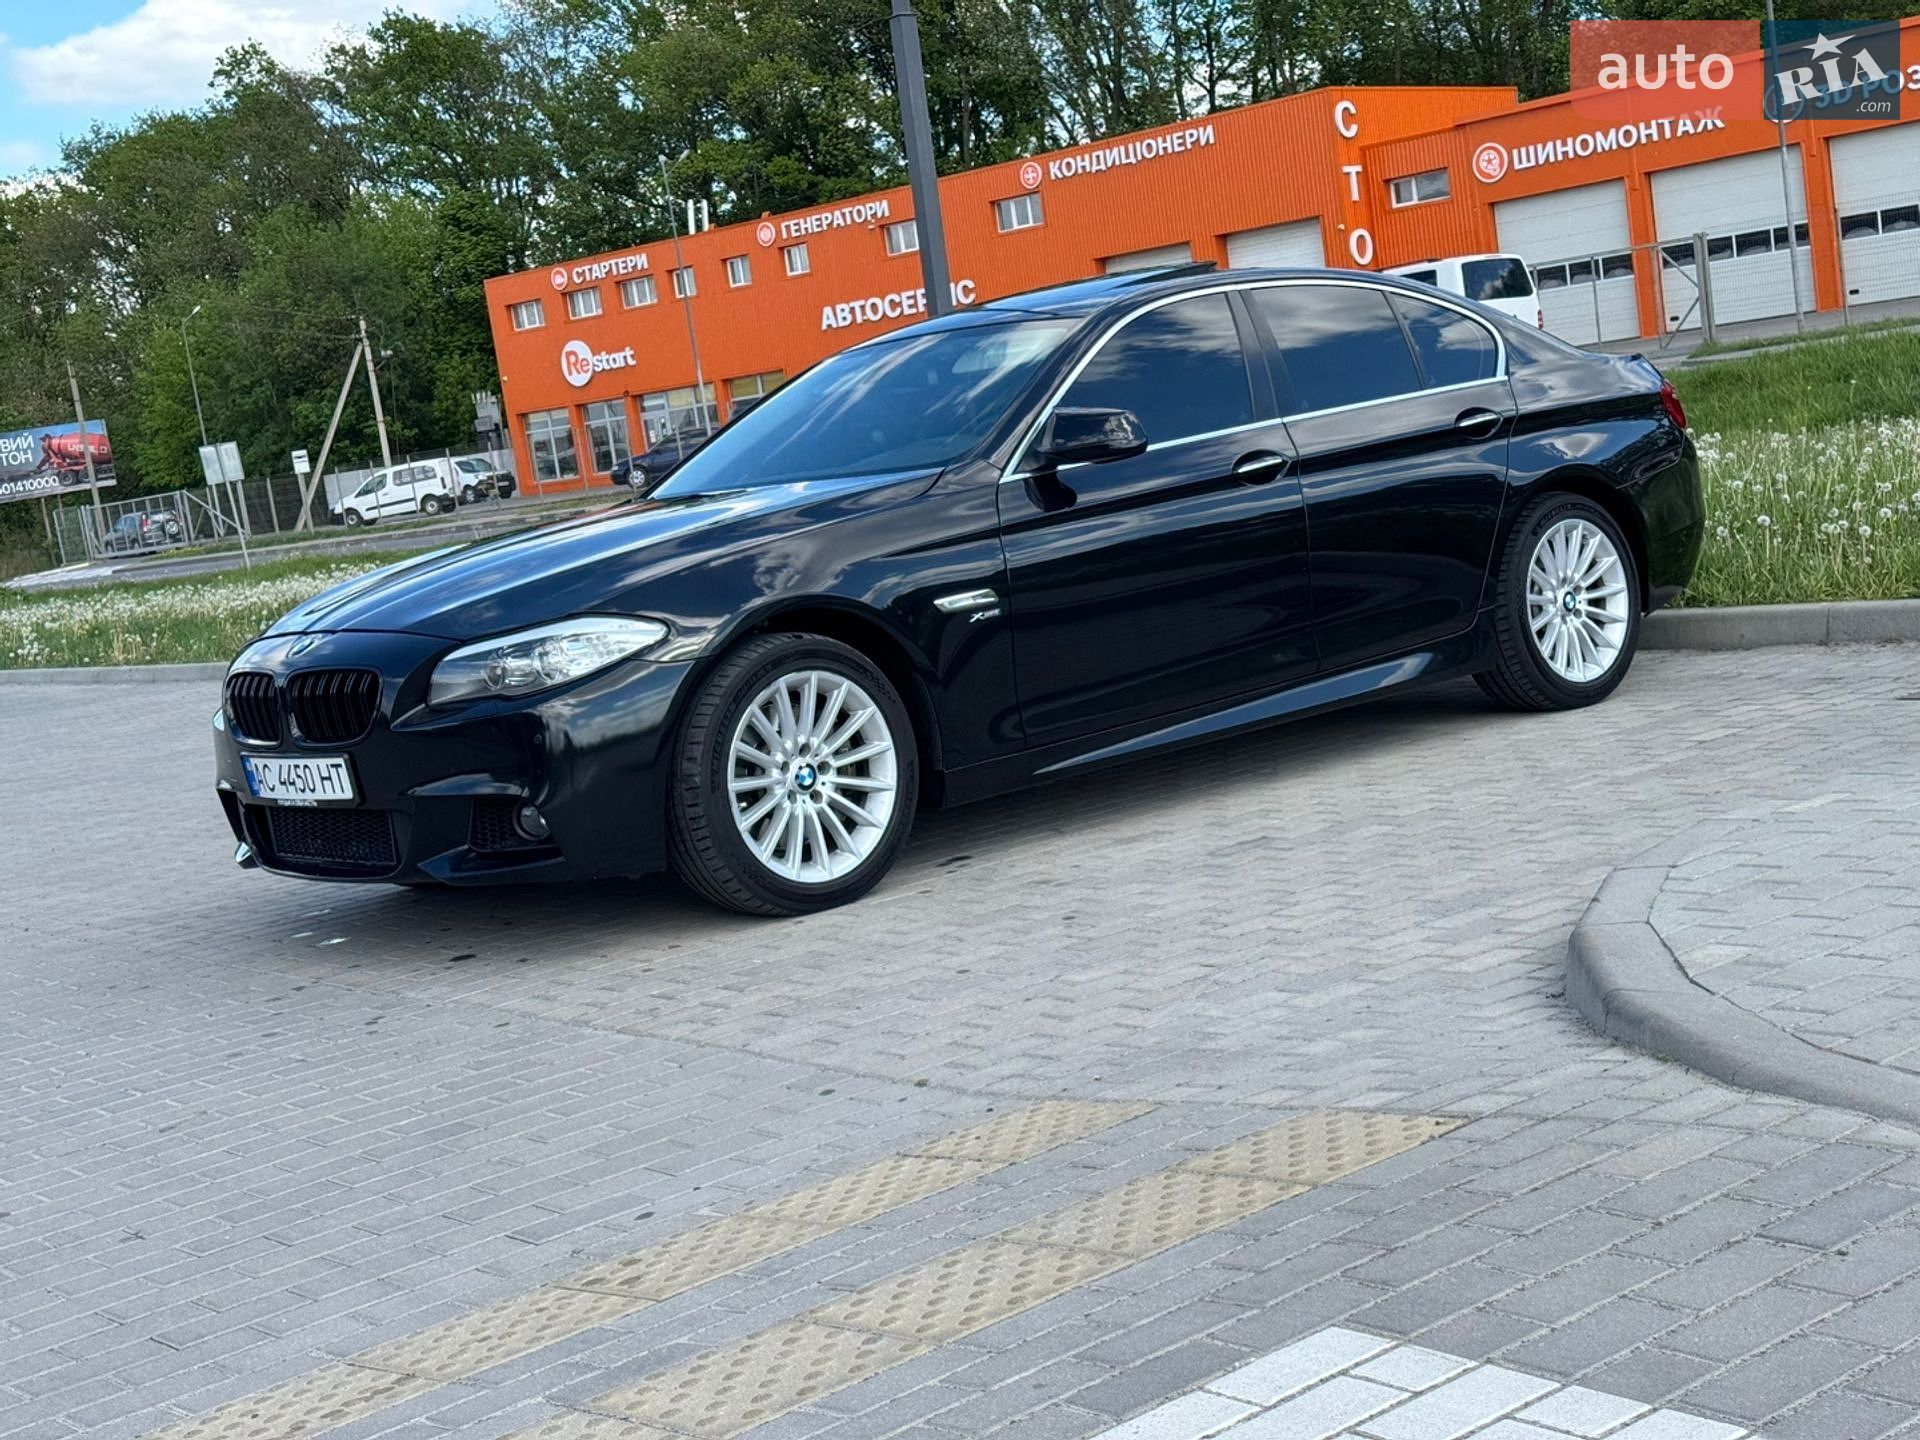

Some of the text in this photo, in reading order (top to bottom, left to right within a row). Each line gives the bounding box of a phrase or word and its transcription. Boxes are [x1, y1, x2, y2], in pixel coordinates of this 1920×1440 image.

[1049, 124, 1215, 181] КОНДИЦІОНЕРИ
[1512, 105, 1726, 171] ШИНОМОНТАЖ
[1334, 100, 1374, 266] СТО
[781, 200, 890, 240] ГЕНЕРАТОРИ
[572, 253, 649, 284] СТАРТЕРИ
[821, 279, 976, 331] АВТОСЕРІС
[564, 345, 637, 378] Restart
[0, 432, 34, 453] ВИЙ
[0, 475, 60, 495] 01410000
[254, 762, 346, 795] AC 4450 HT
